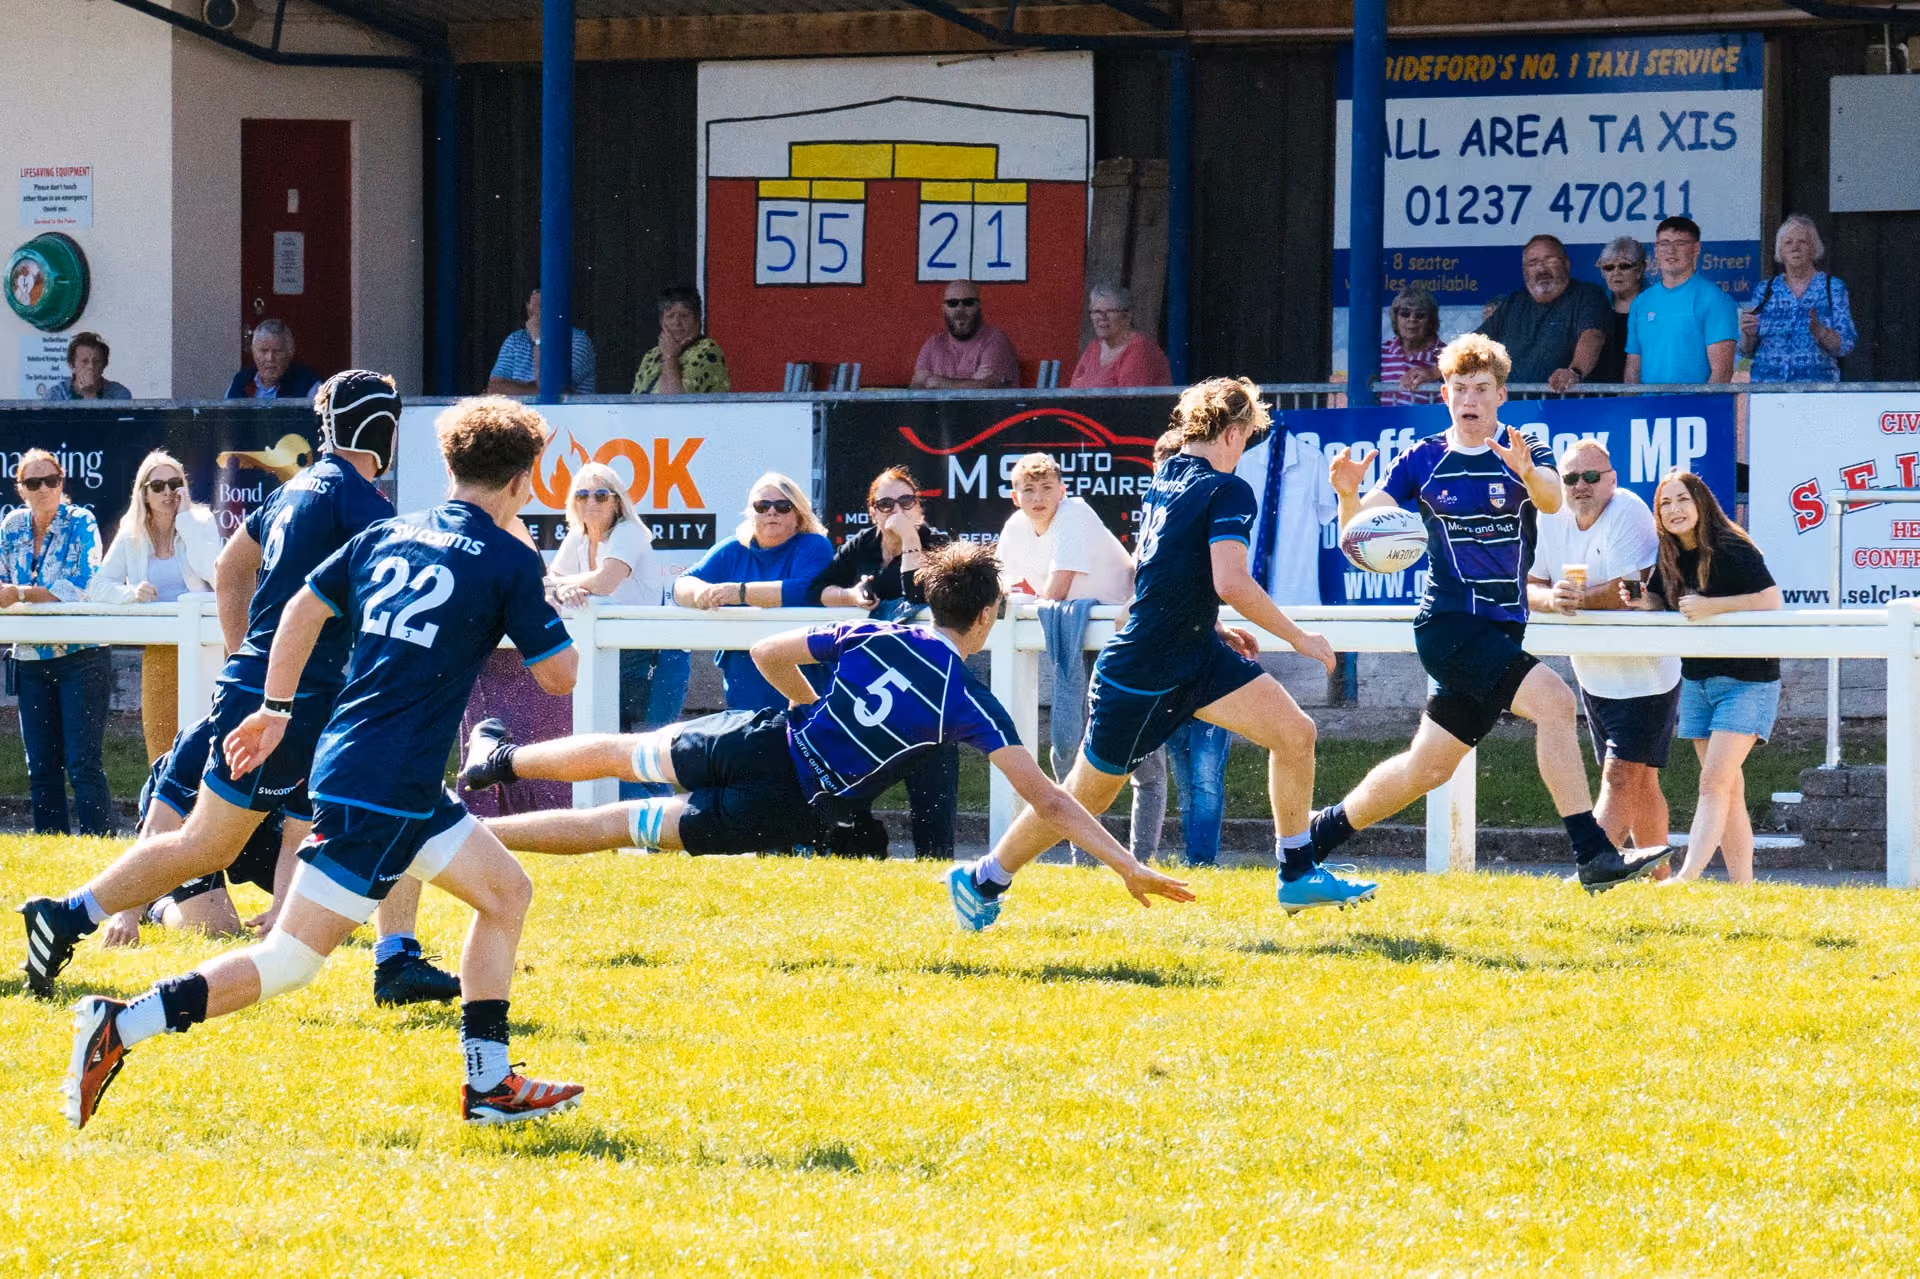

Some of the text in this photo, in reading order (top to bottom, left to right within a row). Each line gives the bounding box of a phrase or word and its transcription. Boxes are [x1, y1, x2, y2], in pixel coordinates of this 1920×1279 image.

[1520, 54, 1559, 80] NO.
[1568, 53, 1579, 78] 1
[1587, 51, 1638, 78] TAXI
[1643, 47, 1741, 77] SERVICE
[1385, 111, 1737, 160] LL AREA TAXIS
[20, 166, 90, 177] LIFESAVING EQUIPMENT
[1405, 180, 1693, 226] 01237 470211
[1393, 253, 1459, 271] 8 seater
[1702, 254, 1751, 270] Street
[1629, 416, 1708, 484] MP
[1049, 452, 1113, 473] UTO
[220, 482, 263, 503] Bond
[1060, 476, 1153, 496] EPAIRS
[652, 523, 723, 540] RITY
[1475, 523, 1494, 534] and
[360, 555, 455, 649] 22
[853, 667, 912, 727] 5
